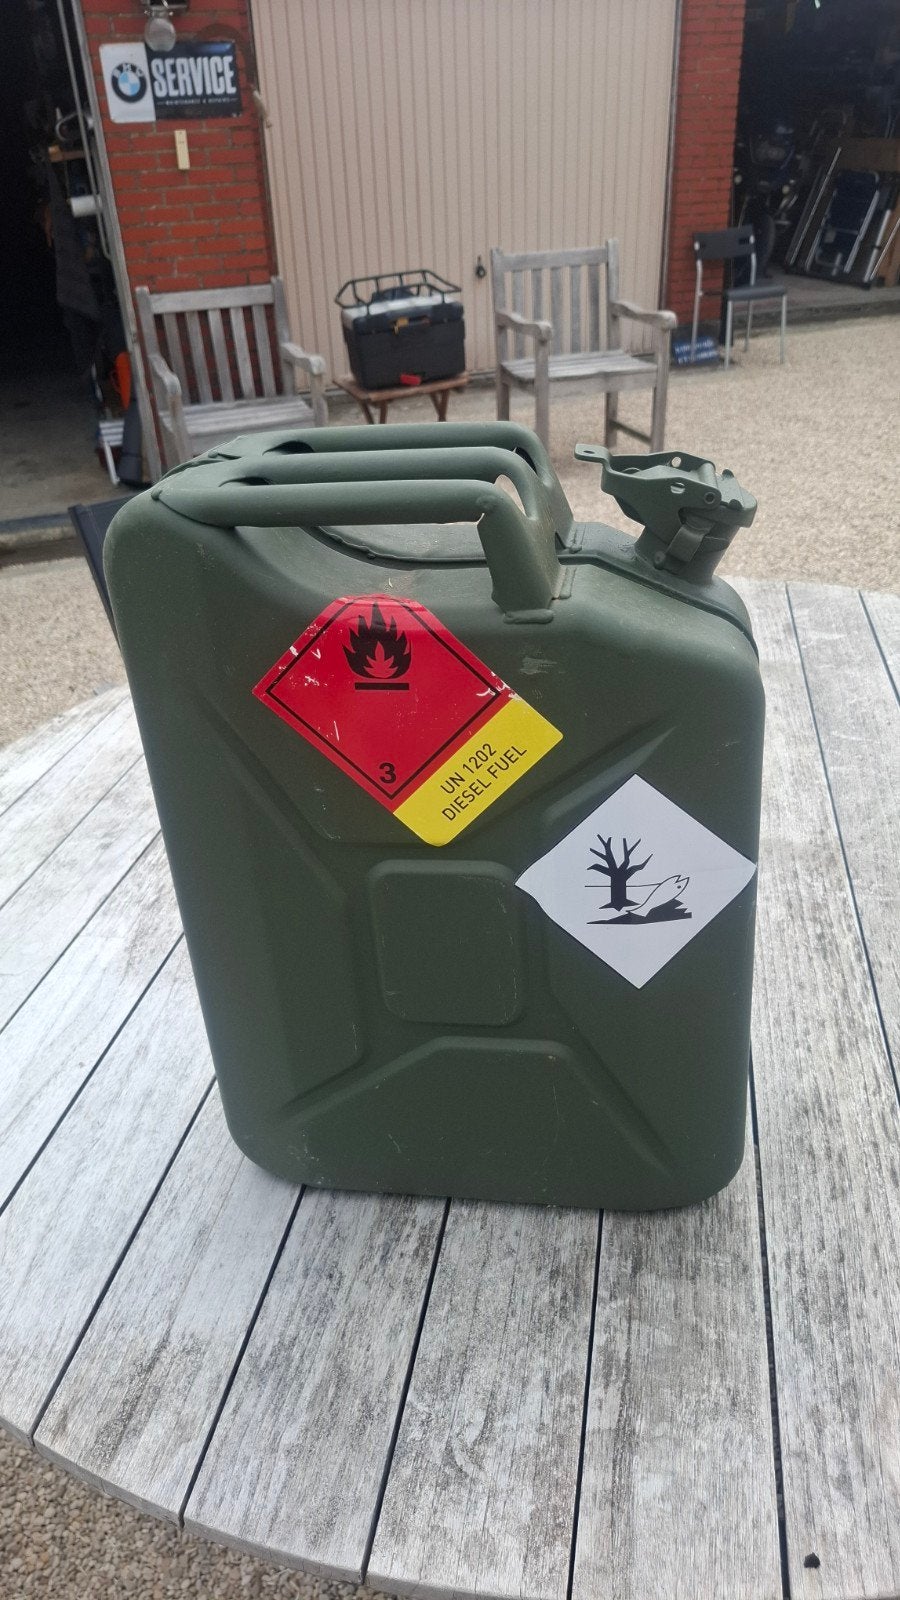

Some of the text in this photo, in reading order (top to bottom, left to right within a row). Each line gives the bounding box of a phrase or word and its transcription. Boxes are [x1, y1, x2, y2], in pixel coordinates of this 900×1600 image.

[150, 55, 237, 98] SERVICE
[379, 762, 397, 784] 3
[440, 743, 497, 794] UN 1202
[441, 745, 527, 821] DIESEL FUEL
